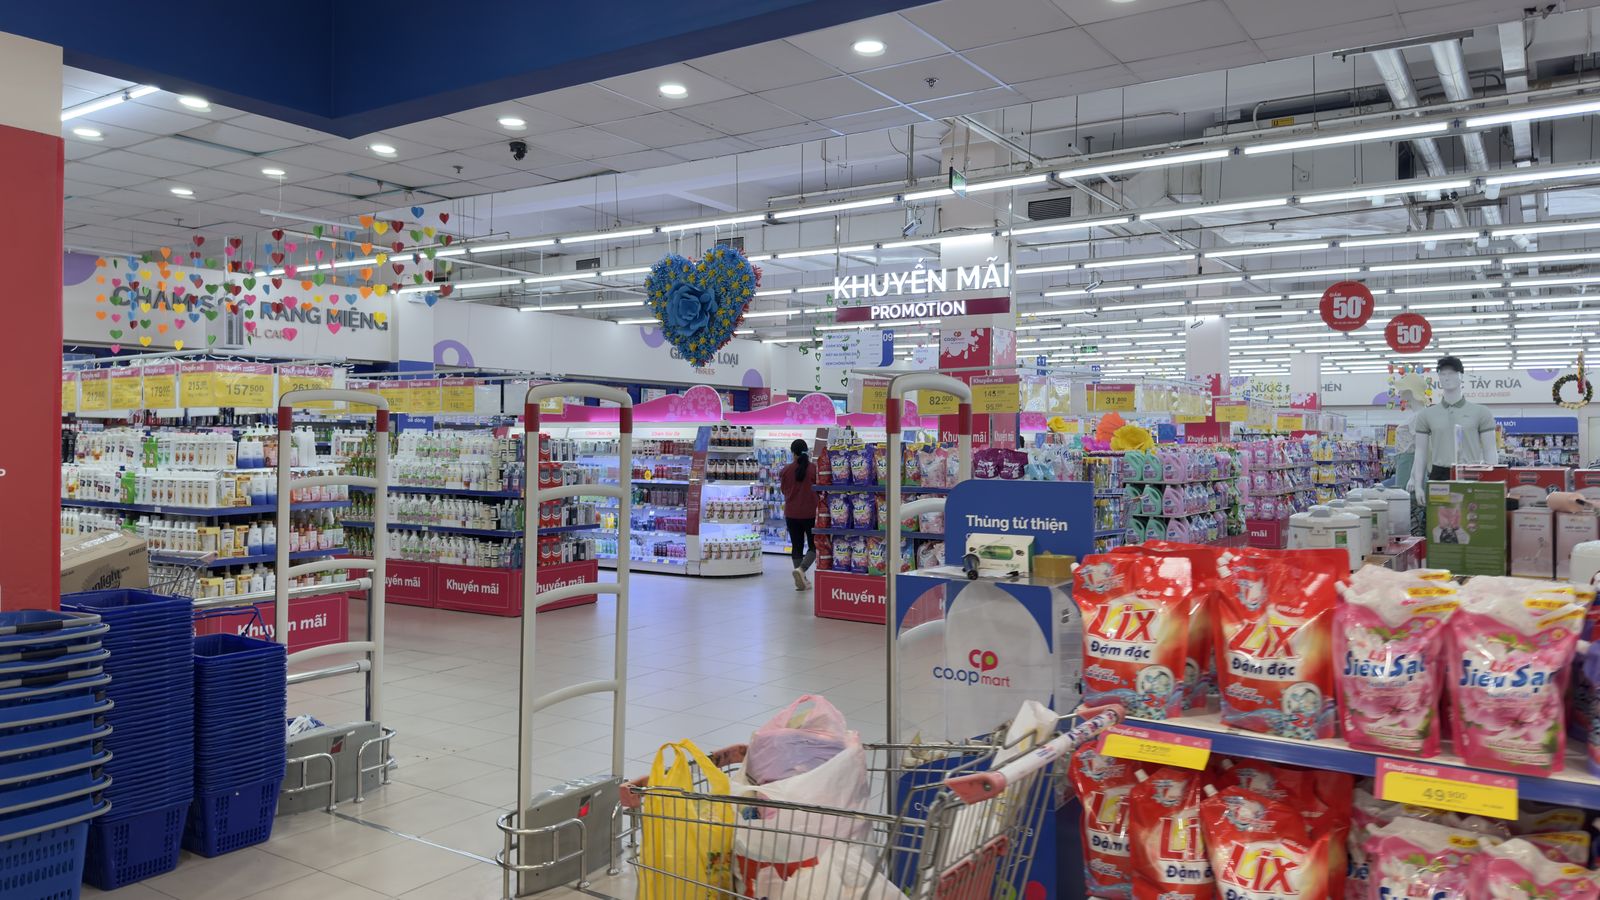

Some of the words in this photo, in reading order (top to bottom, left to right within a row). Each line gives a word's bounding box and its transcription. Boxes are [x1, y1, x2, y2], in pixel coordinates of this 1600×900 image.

[834, 257, 947, 300] KHUYẾN
[957, 255, 1010, 291] MÃI
[870, 300, 966, 320] PROMOTION
[882, 333, 893, 342] 09
[1031, 517, 1068, 533] thiện
[404, 576, 421, 588] mãi
[446, 578, 479, 594] Khuyến
[481, 581, 499, 594] mãi
[831, 587, 875, 605] Khuyến
[301, 613, 327, 630] mãi
[1091, 640, 1122, 657] Đậm
[1124, 645, 1151, 661] đặc
[1231, 657, 1264, 675] Đậm
[1266, 663, 1296, 679] đặc
[1165, 865, 1200, 881] Đậm
[1220, 840, 1301, 895] Lix
